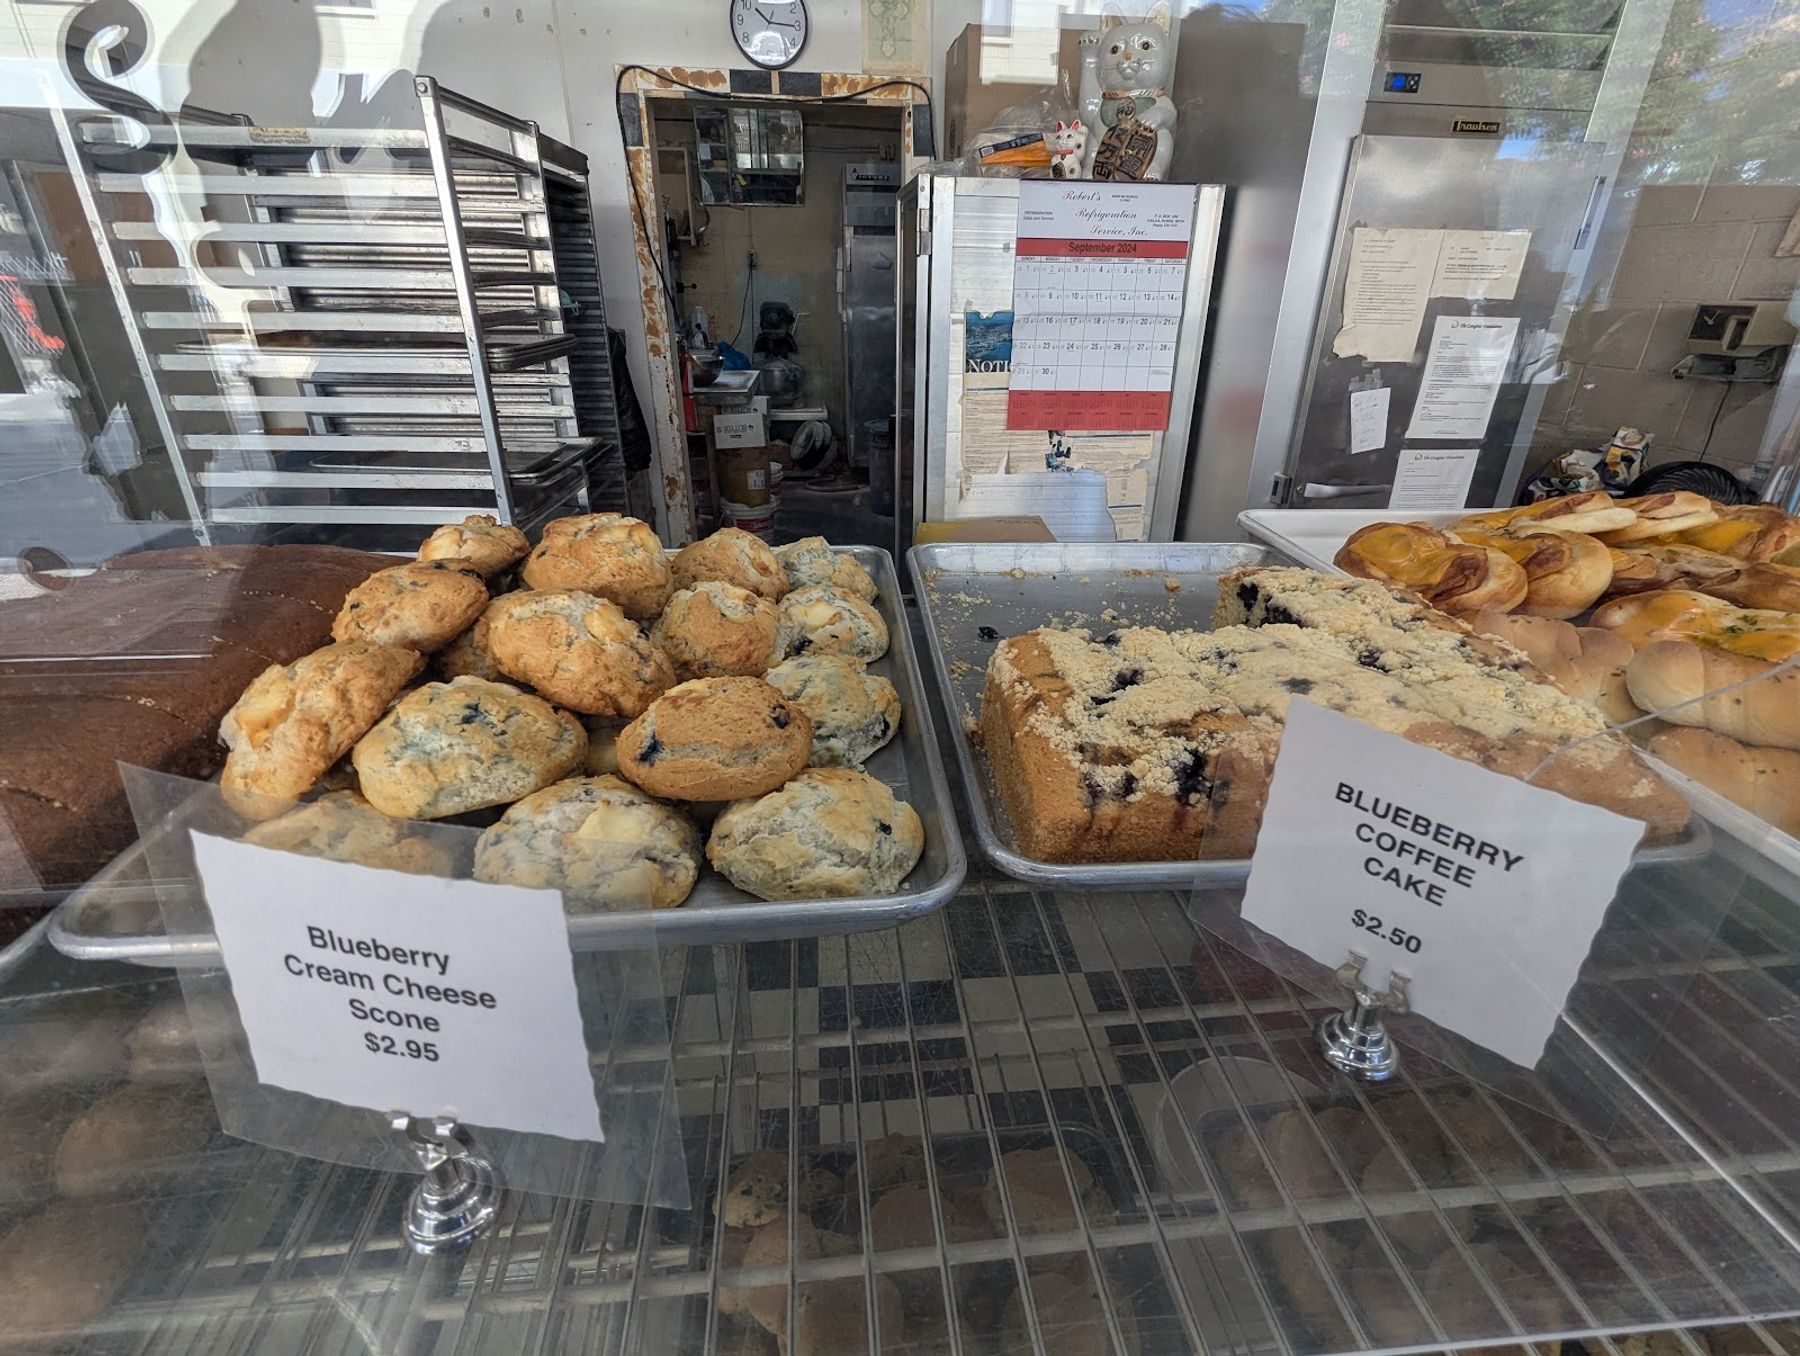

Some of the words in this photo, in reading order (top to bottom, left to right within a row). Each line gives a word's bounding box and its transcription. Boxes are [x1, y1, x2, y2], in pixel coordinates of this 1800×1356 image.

[737, 14, 744, 25] 9
[790, 2, 797, 14] 2
[742, 31, 750, 43] 8
[794, 20, 802, 31] 3
[1075, 208, 1137, 221] Refrigeration
[1069, 242, 1115, 254] September
[1117, 243, 1137, 253] 2024
[1335, 782, 1524, 873] BLUEBERRY
[1354, 822, 1477, 888] COFFEE
[1363, 856, 1447, 907] CAKE
[1351, 908, 1423, 954] $2.50
[306, 925, 450, 975] Blueberry
[283, 953, 376, 991] Cream
[383, 974, 497, 1009] Cheese
[348, 998, 441, 1032] Scone
[364, 1031, 440, 1063] $2.95
